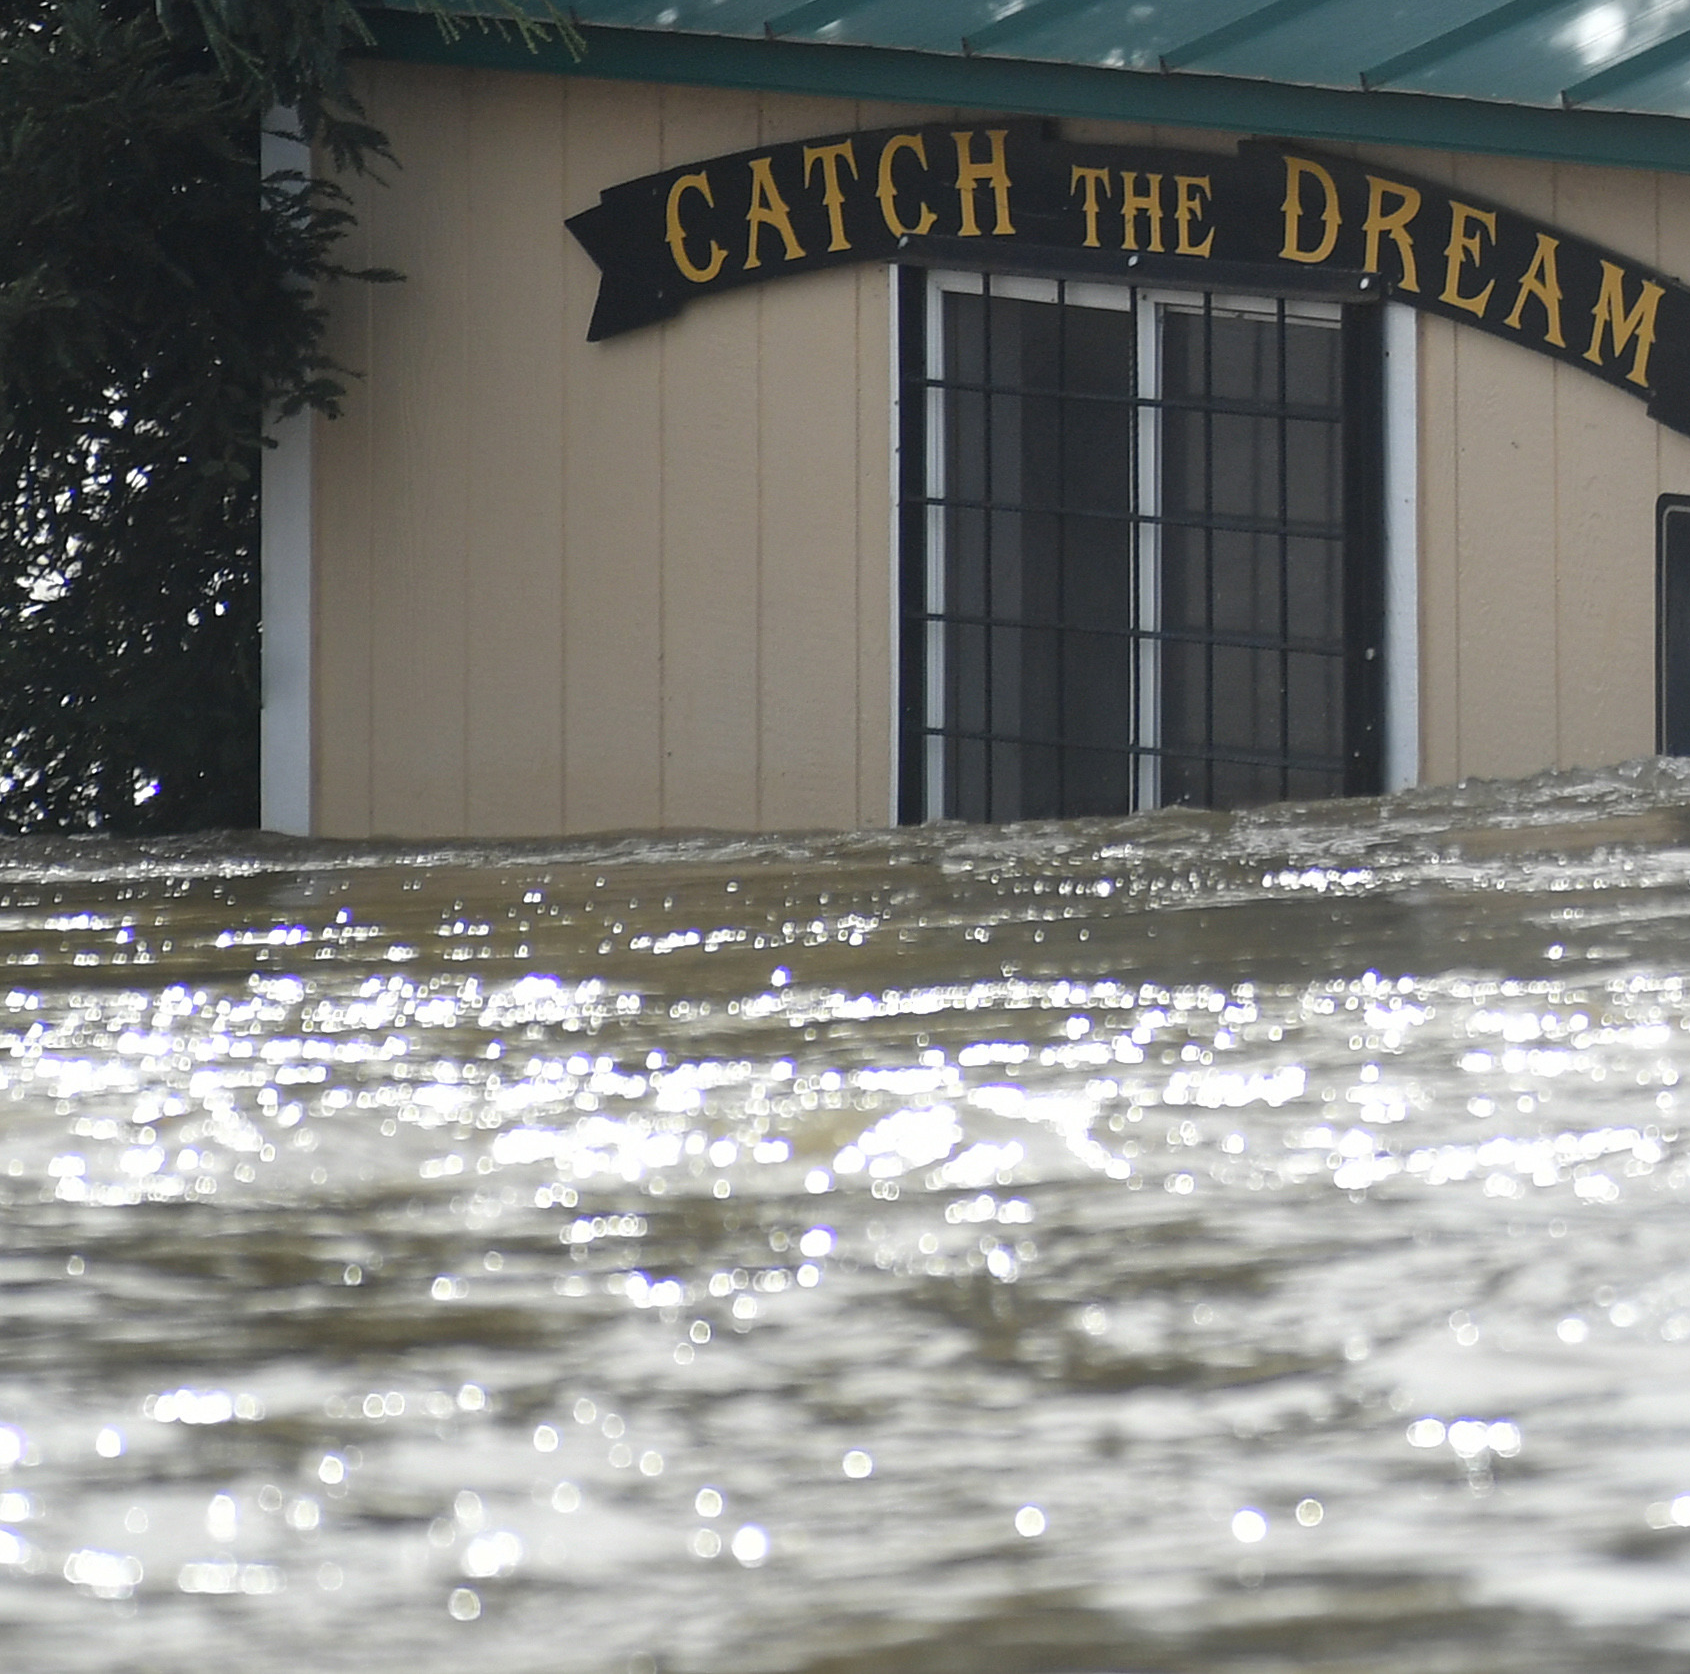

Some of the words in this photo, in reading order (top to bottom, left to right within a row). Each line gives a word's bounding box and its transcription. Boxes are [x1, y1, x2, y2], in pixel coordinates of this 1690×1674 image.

[665, 129, 1017, 283] CATCH
[1069, 164, 1217, 260] THE
[1278, 155, 1667, 389] DREAM
